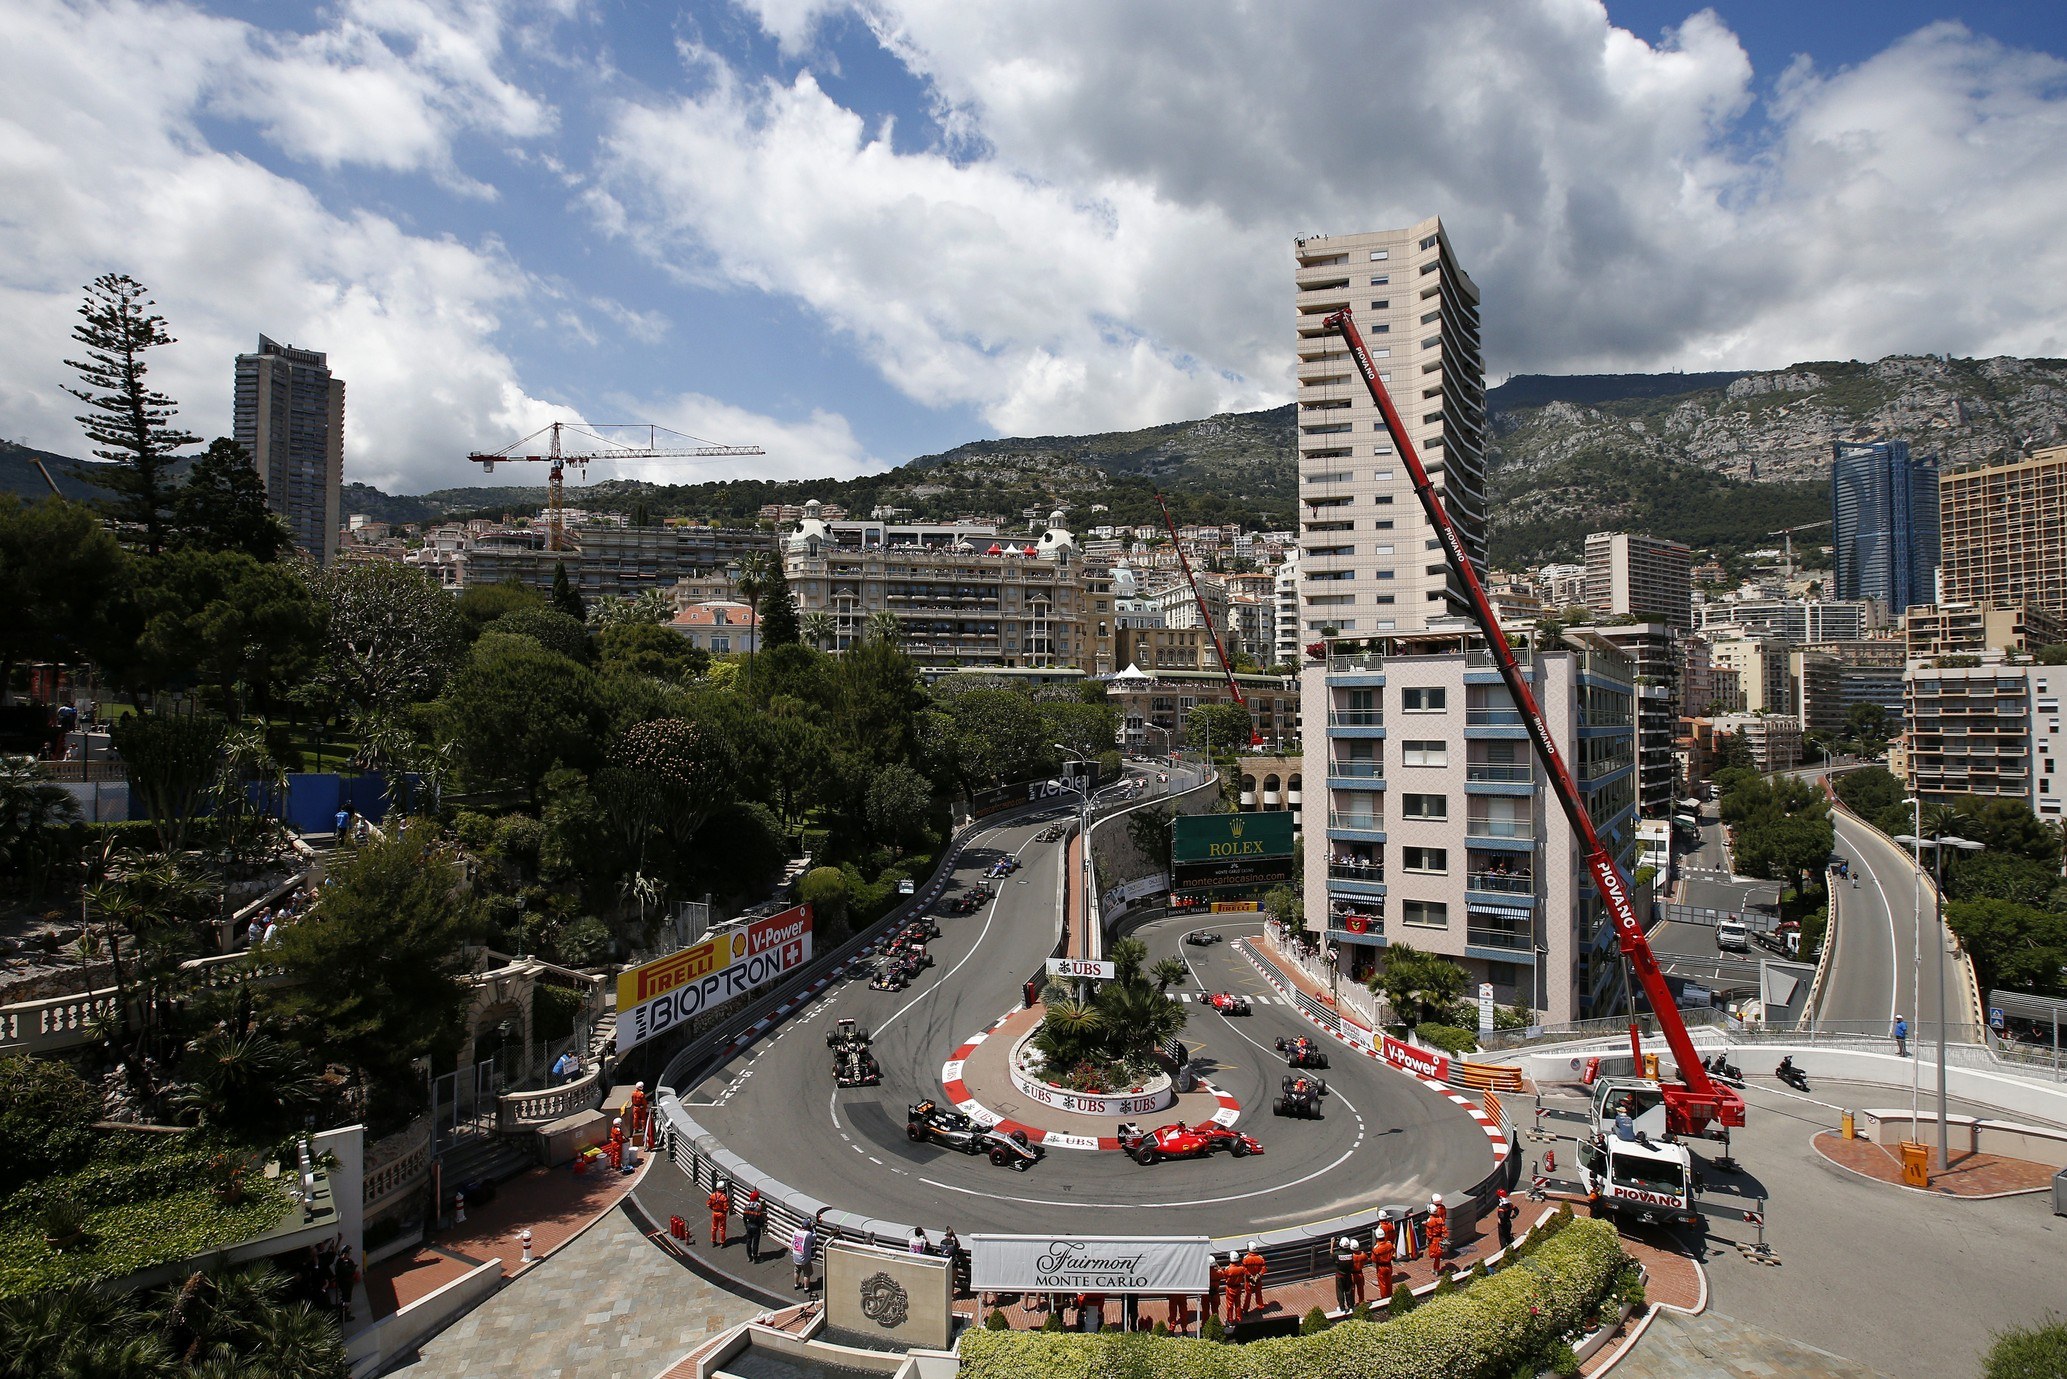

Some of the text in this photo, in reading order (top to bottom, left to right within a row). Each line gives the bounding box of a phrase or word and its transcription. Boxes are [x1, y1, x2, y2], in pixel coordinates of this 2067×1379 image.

[1355, 346, 1375, 380] PIOVANO
[1444, 527, 1465, 563] PIOVANO
[1533, 717, 1555, 754] PIOVANO
[1209, 841, 1264, 857] ROLEX
[1182, 872, 1285, 888] montecarlocasino.com
[1597, 862, 1636, 929] PIOVANO
[1218, 902, 1251, 912] PIRELLI
[752, 920, 804, 952] V-Power
[637, 943, 715, 1001] PIRELLI
[1073, 962, 1102, 975] UBS
[650, 947, 780, 1033] BIOPTRON
[1387, 1043, 1438, 1077] V-Power
[716, 1071, 754, 1107] TAXIS
[1030, 1086, 1052, 1103] UBS
[1077, 1099, 1106, 1113] UBS
[1133, 1096, 1156, 1112] UBS
[974, 1109, 994, 1124] UBS
[1065, 1137, 1095, 1147] UBS
[1614, 1187, 1682, 1208] PIOVANO
[1036, 1240, 1146, 1275] Fairmont
[1035, 1275, 1148, 1288] MONTE CARLO
